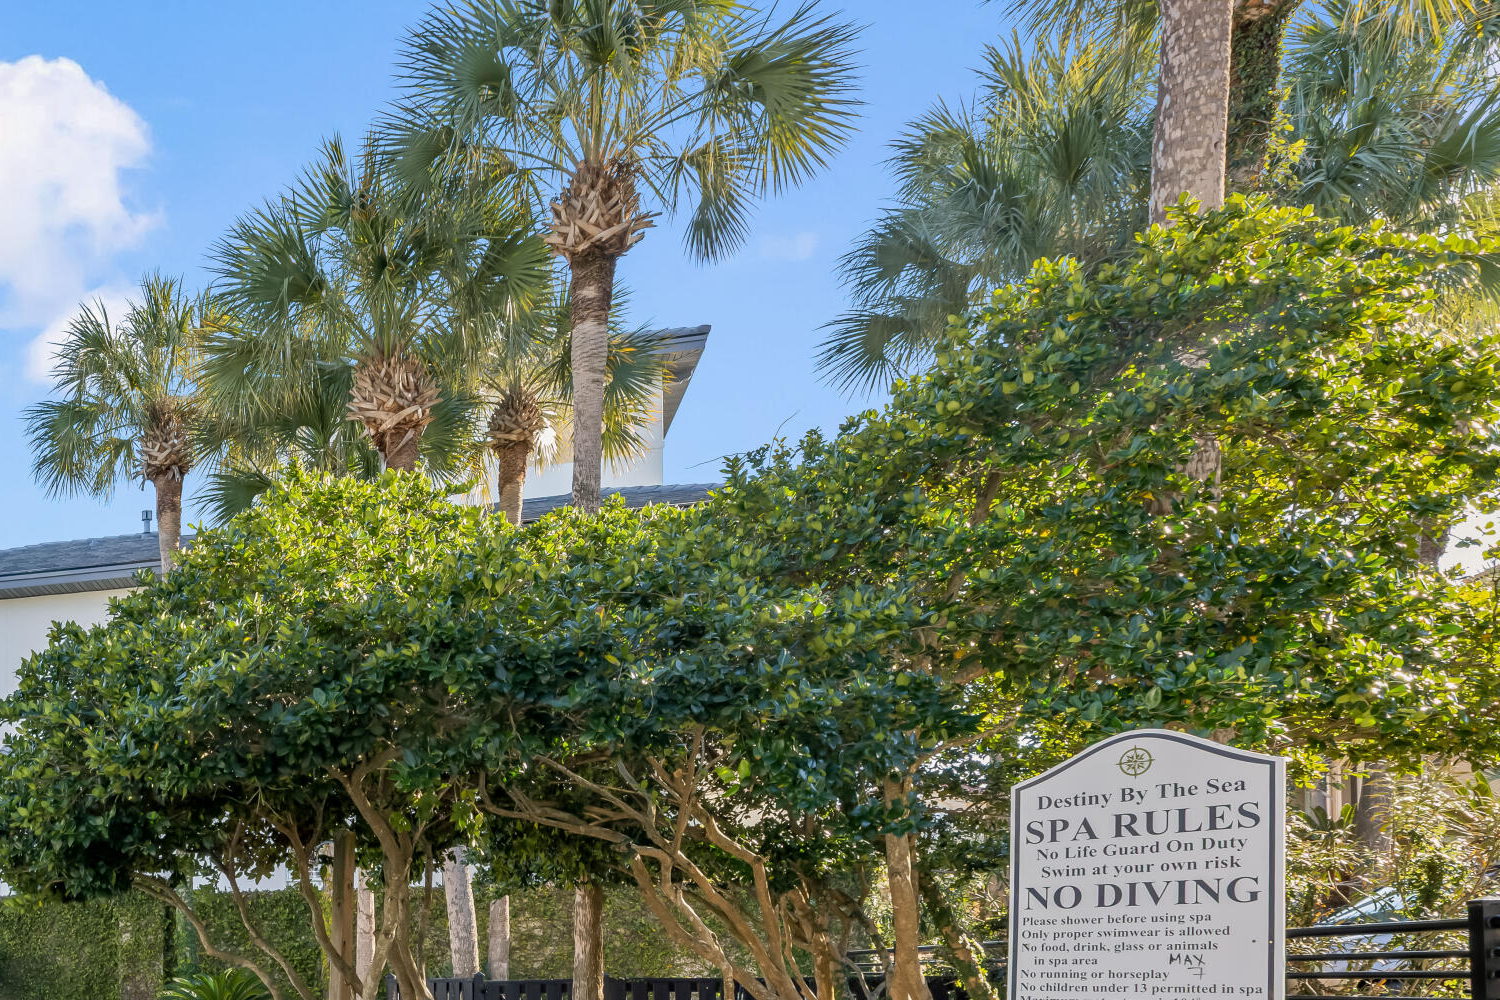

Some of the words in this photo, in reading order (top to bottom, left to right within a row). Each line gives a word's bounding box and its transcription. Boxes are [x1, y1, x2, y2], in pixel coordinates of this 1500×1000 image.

[1038, 792, 1112, 810] Destiny
[1121, 788, 1148, 804] By
[1156, 782, 1198, 798] The
[1206, 778, 1246, 794] Sea
[1026, 817, 1099, 845] SPA
[1112, 802, 1260, 838] RULES
[1037, 848, 1058, 860] No
[1065, 846, 1097, 859] Life
[1103, 841, 1160, 856] Guard
[1167, 840, 1194, 852] On
[1202, 837, 1248, 851] Duty
[1041, 866, 1086, 878] Swim
[1092, 864, 1107, 875] at
[1113, 863, 1154, 877] your
[1160, 861, 1197, 872] own
[1205, 856, 1242, 869] risk
[1024, 885, 1082, 910] NO
[1094, 876, 1262, 908] DIVING
[1023, 917, 1057, 926] Please
[1061, 916, 1103, 925] shower
[1107, 914, 1147, 924] before
[1151, 913, 1185, 924] using
[1189, 913, 1212, 922] spa
[1022, 930, 1048, 940] Only
[1053, 929, 1094, 939] proper
[1097, 928, 1160, 937] swimwear
[1165, 927, 1175, 936] is
[1179, 926, 1230, 936] allowed
[1021, 944, 1037, 952] No
[1041, 942, 1069, 953] food,
[1074, 942, 1110, 952] drink,
[1114, 942, 1144, 952] glass
[1148, 943, 1162, 951] or
[1167, 941, 1218, 951] animals
[1034, 956, 1045, 965] in
[1048, 957, 1067, 967] spa
[1169, 953, 1206, 966] MAX
[1021, 970, 1036, 979] No
[1040, 970, 1087, 980] running
[1108, 970, 1169, 981] horseplay
[1020, 983, 1036, 992] No
[1040, 983, 1088, 992] children
[1092, 983, 1129, 993] under
[1134, 983, 1147, 993] 13
[1152, 984, 1217, 995] permitted
[1222, 985, 1234, 994] in
[1239, 986, 1263, 996] spa
